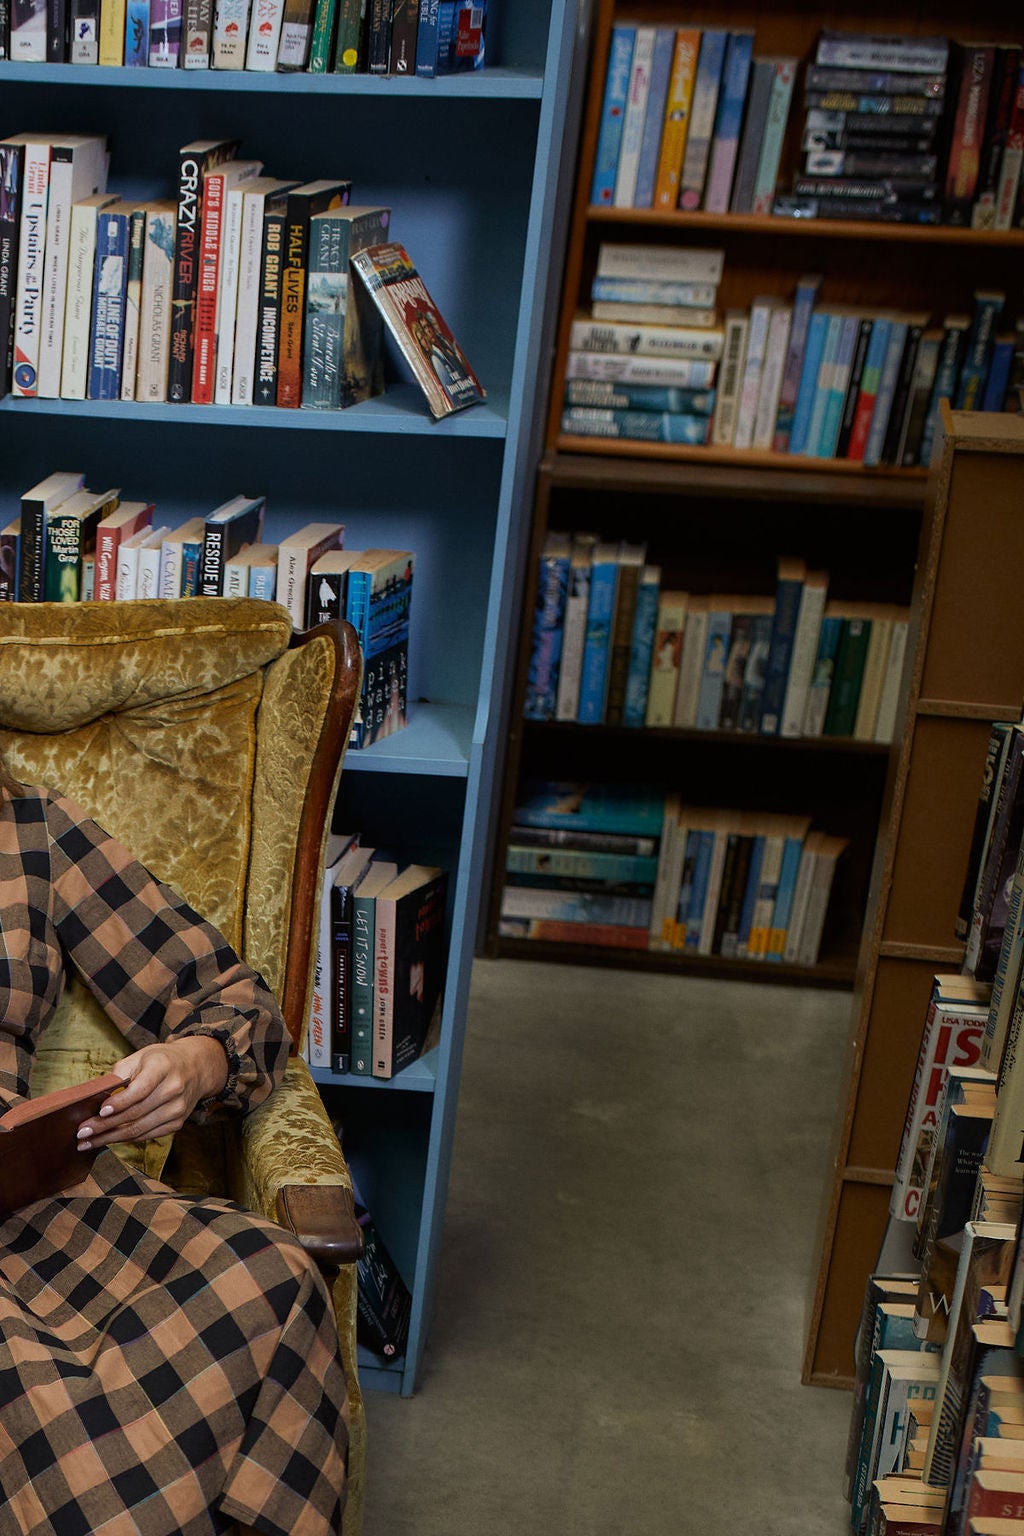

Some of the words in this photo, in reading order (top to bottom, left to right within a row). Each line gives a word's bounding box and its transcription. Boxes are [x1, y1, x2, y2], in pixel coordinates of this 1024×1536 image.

[27, 161, 37, 194] Grant
[37, 162, 47, 194] Linda
[208, 177, 221, 207] GOD'S
[177, 159, 199, 233] CRAZY
[25, 203, 43, 270] Upstairs
[205, 210, 218, 248] MIDDLE
[267, 223, 281, 252] ROB
[0, 238, 10, 263] LINDA
[179, 232, 195, 284] RIVER
[287, 224, 303, 267] HALF
[319, 224, 331, 270] GRANT
[329, 224, 341, 267] TRACY
[0, 265, 9, 297] GRANT
[264, 255, 279, 299] GRANT
[286, 270, 300, 313] LIVES
[19, 287, 39, 338] Party
[95, 297, 108, 337] MICHAEL
[107, 297, 121, 324] LINE
[151, 285, 164, 332] NICHOLAS
[107, 324, 119, 341] OF
[172, 332, 181, 360] GRANT
[177, 329, 187, 363] RICHARD
[94, 338, 105, 368] GRANT
[105, 342, 118, 371] DUTY
[150, 334, 161, 364] GRANT
[200, 338, 210, 365] RICHARD
[286, 338, 294, 359] Grant
[199, 366, 208, 385] GRANT
[47, 527, 75, 536] THOSE
[61, 520, 80, 528] FOR
[51, 536, 79, 545] LOVED
[52, 545, 79, 554] Martin
[102, 536, 113, 551] Will
[58, 554, 78, 564] Gray
[99, 552, 112, 582] Grayson,
[204, 533, 221, 581] RESCUE
[288, 556, 296, 574] Alex
[99, 583, 110, 600] Will
[287, 578, 295, 611] Grecian
[356, 910, 368, 934] LET
[357, 937, 368, 950] IT
[355, 953, 368, 986] SNOW
[377, 956, 389, 994] towns
[313, 1018, 321, 1046] GREEN
[941, 1017, 958, 1026] USA
